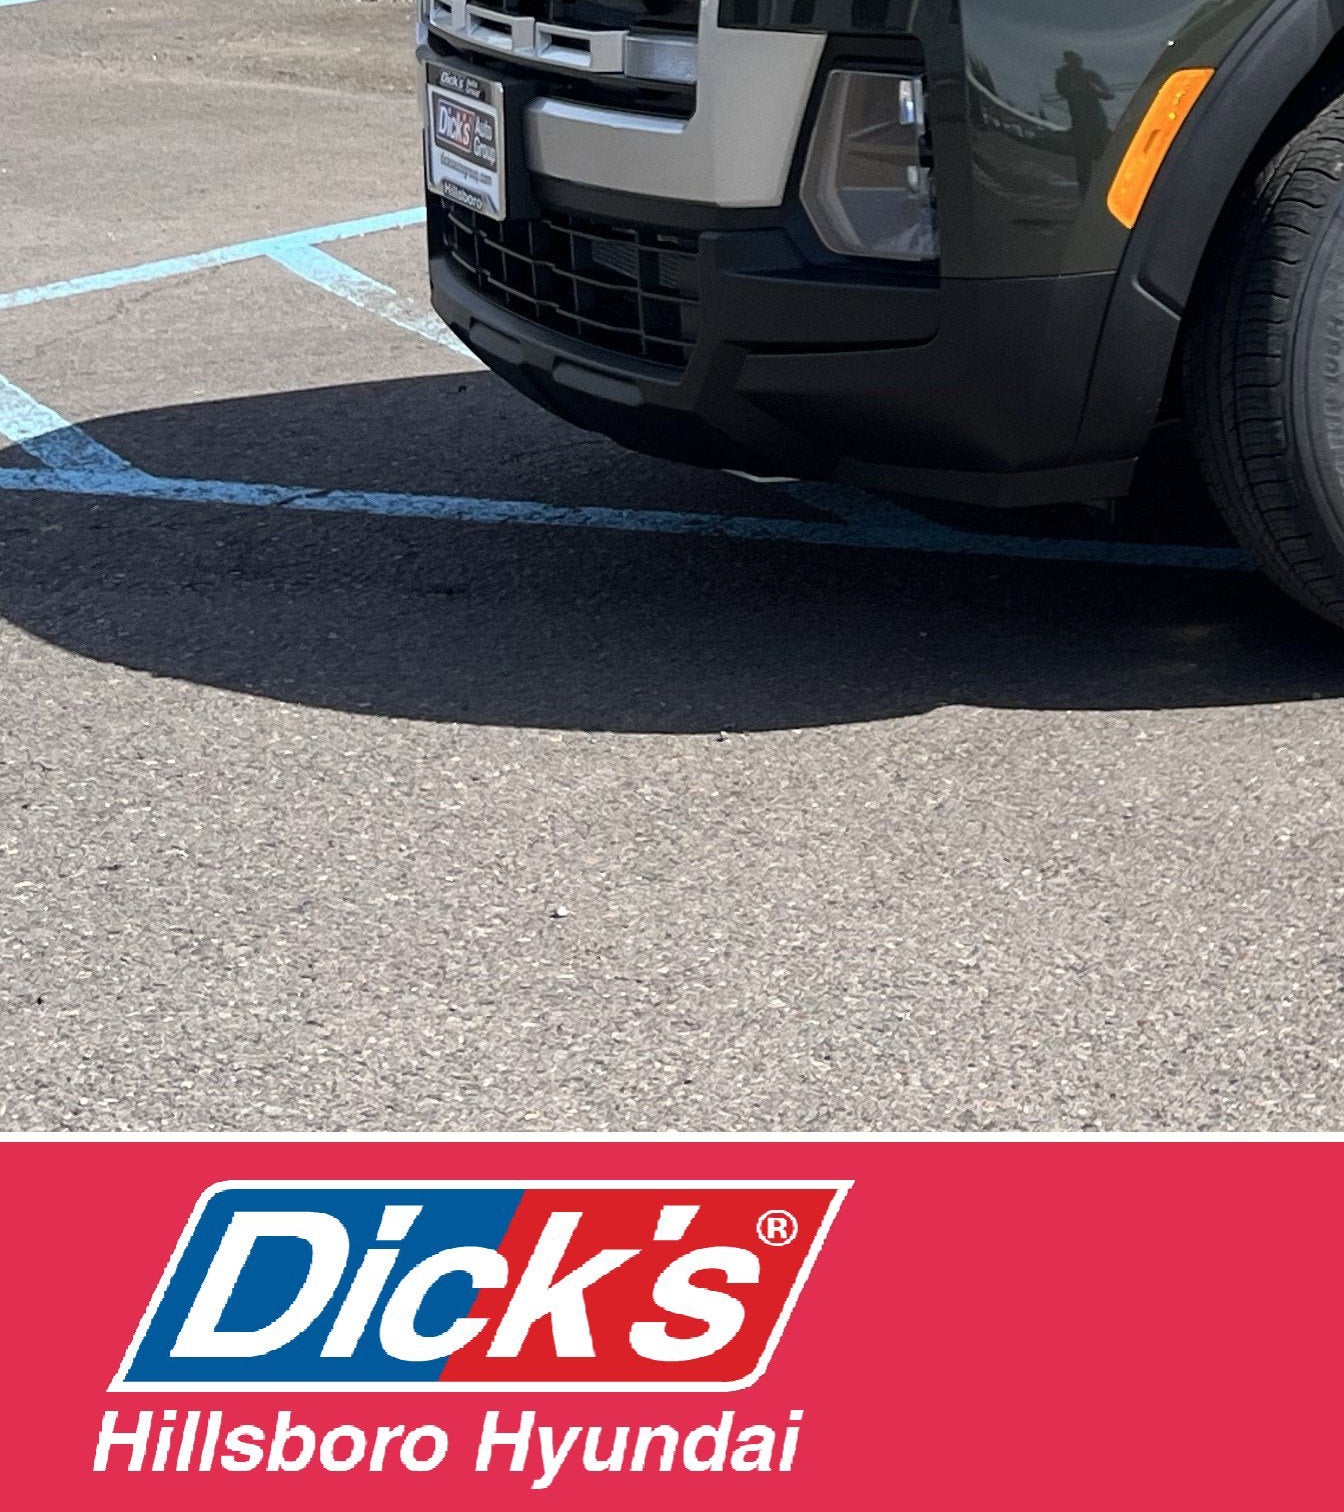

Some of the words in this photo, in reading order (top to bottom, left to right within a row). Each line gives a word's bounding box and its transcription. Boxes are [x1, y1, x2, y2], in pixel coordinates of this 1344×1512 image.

[438, 105, 471, 147] Dick's
[475, 115, 494, 141] Auto
[473, 136, 496, 167] Group
[443, 181, 483, 210] Hillsboro
